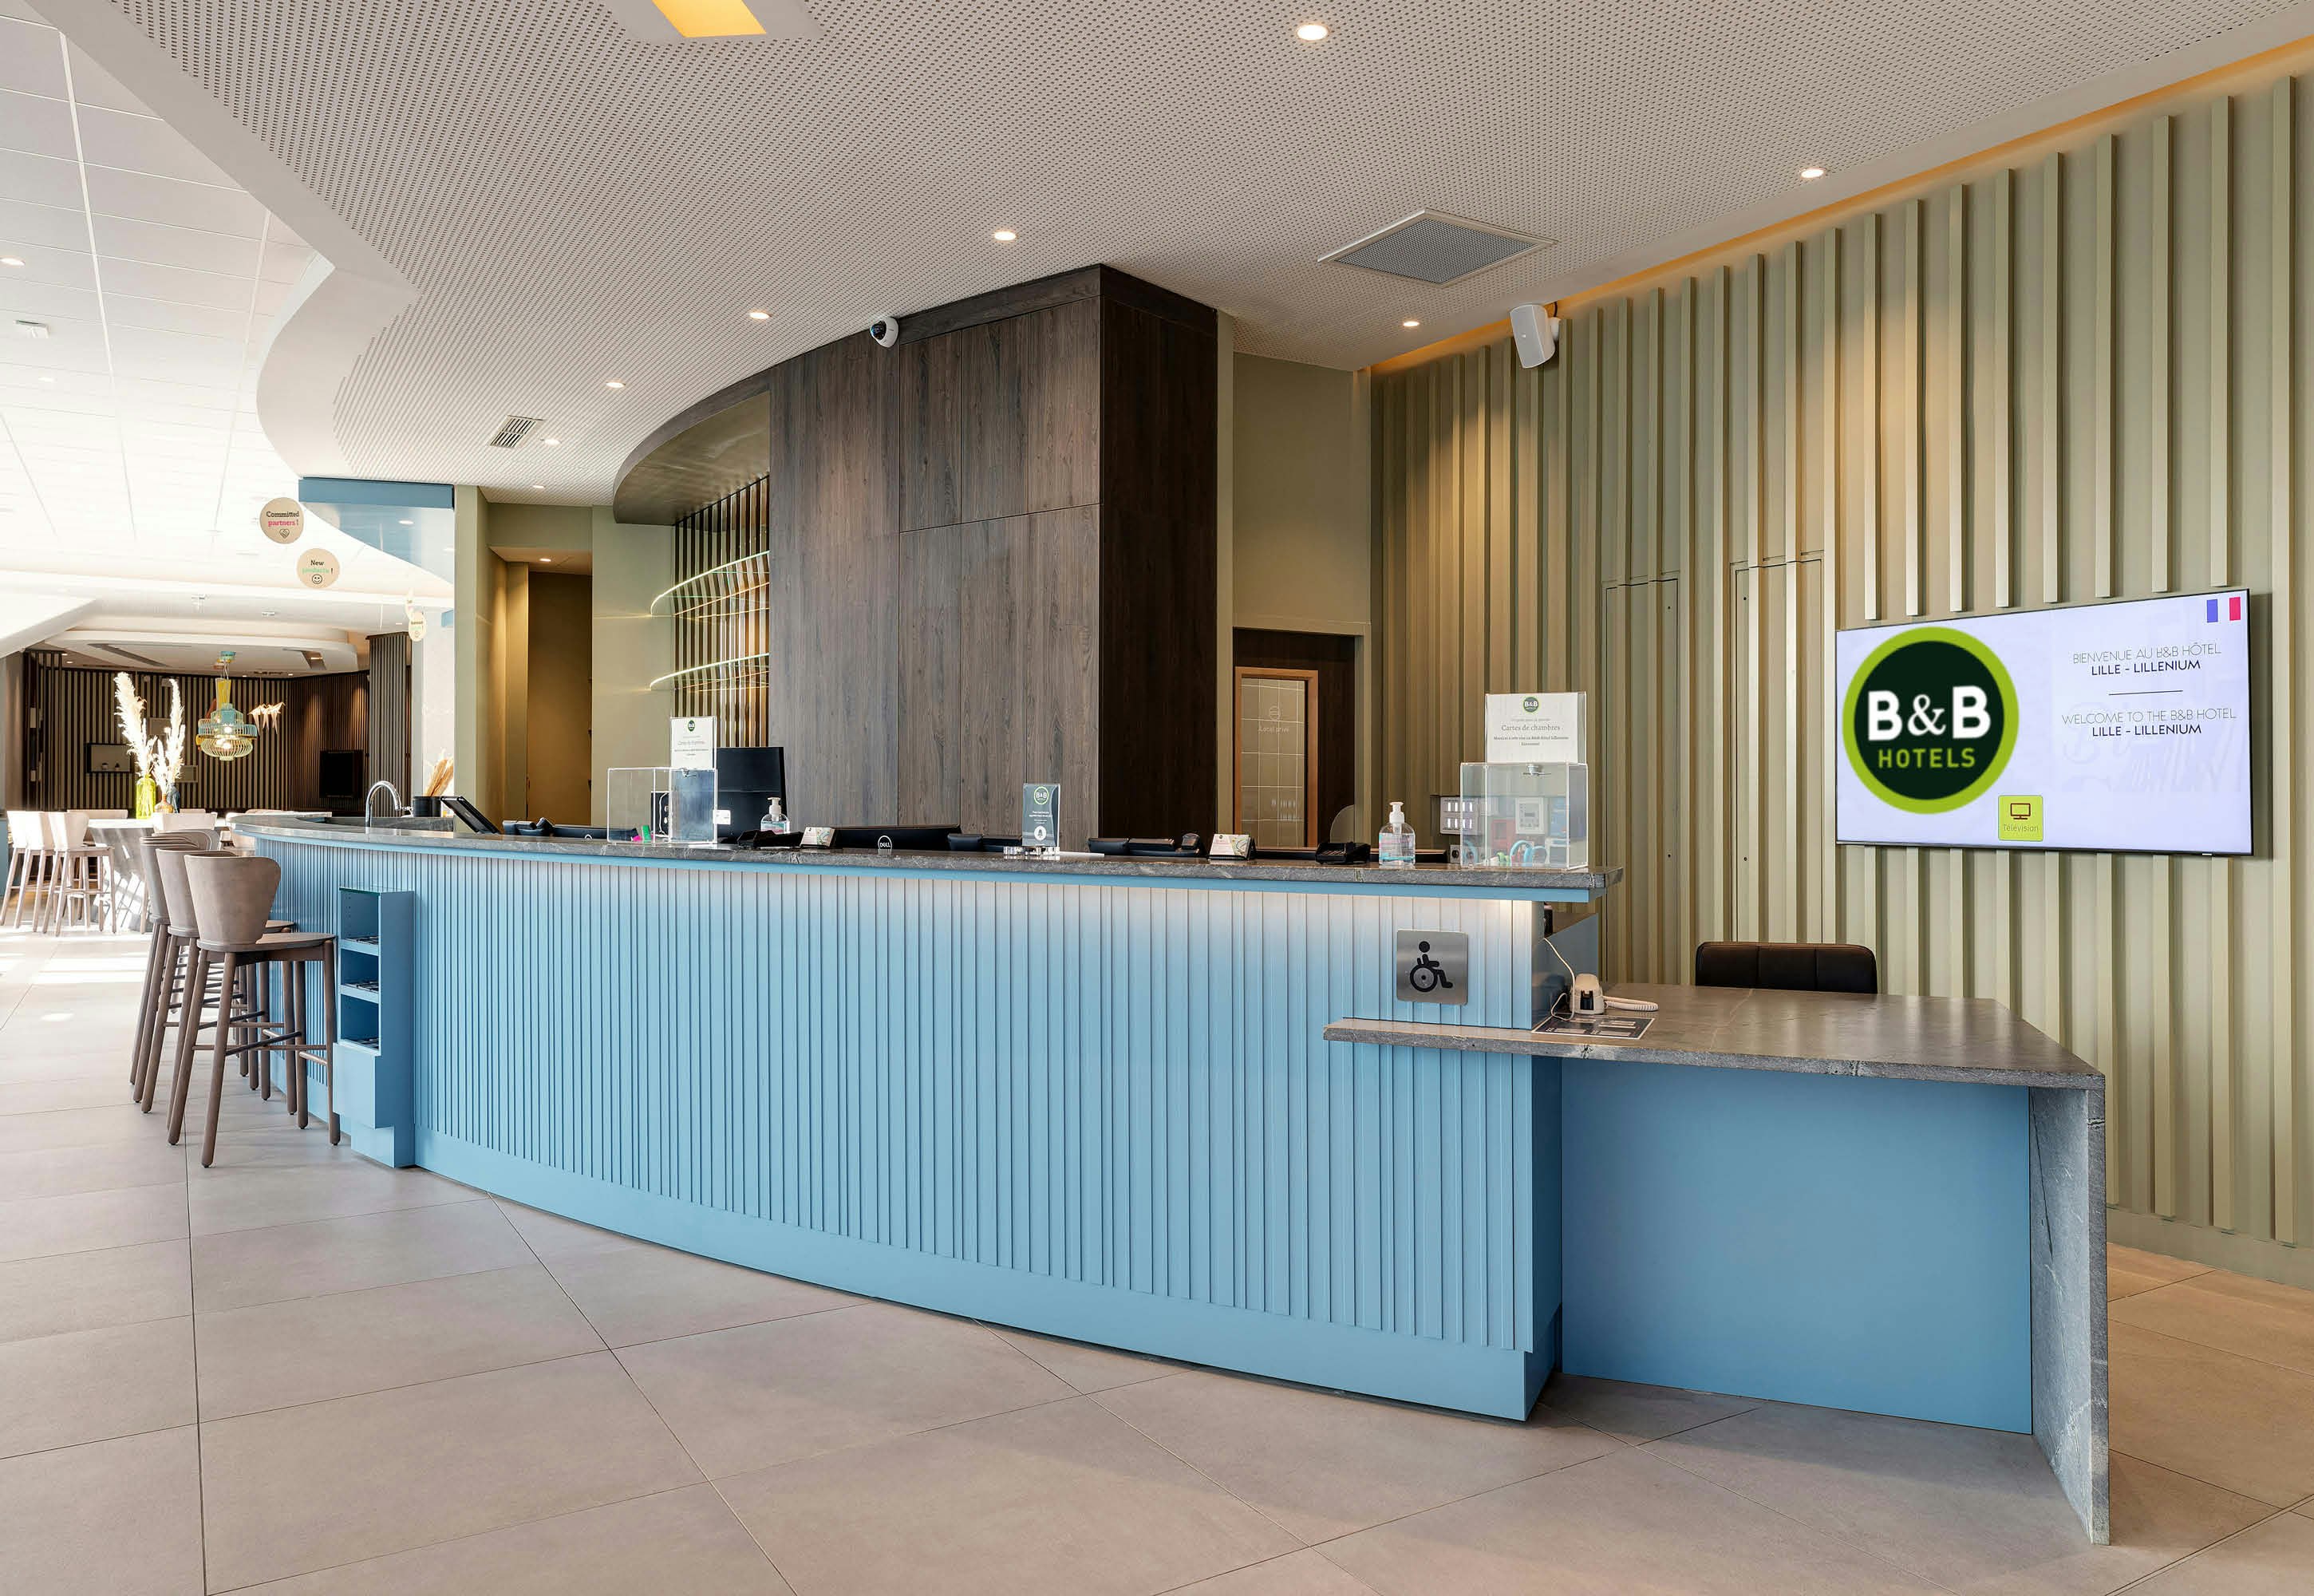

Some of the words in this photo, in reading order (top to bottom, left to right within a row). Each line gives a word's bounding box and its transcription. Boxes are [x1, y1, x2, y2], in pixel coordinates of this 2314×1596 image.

[2073, 649, 2132, 664] BIENVENUE
[2136, 647, 2154, 659] AU
[2156, 645, 2179, 658] B&B
[2182, 642, 2222, 656] HÔTEL
[2091, 664, 2121, 676] LILLE
[2134, 659, 2201, 674] LILLENIUM
[1868, 685, 1991, 741] B&B
[2062, 712, 2123, 725] WELCOME
[2127, 711, 2144, 722] TO
[2147, 710, 2167, 722] THE
[2170, 709, 2194, 721] B&B
[2197, 707, 2237, 720] HOTEL
[2092, 726, 2122, 737] LILLE
[2134, 723, 2202, 736] LILLENIUM
[1878, 747, 1976, 769] HOTELS
[2004, 824, 2039, 832] Télévision
